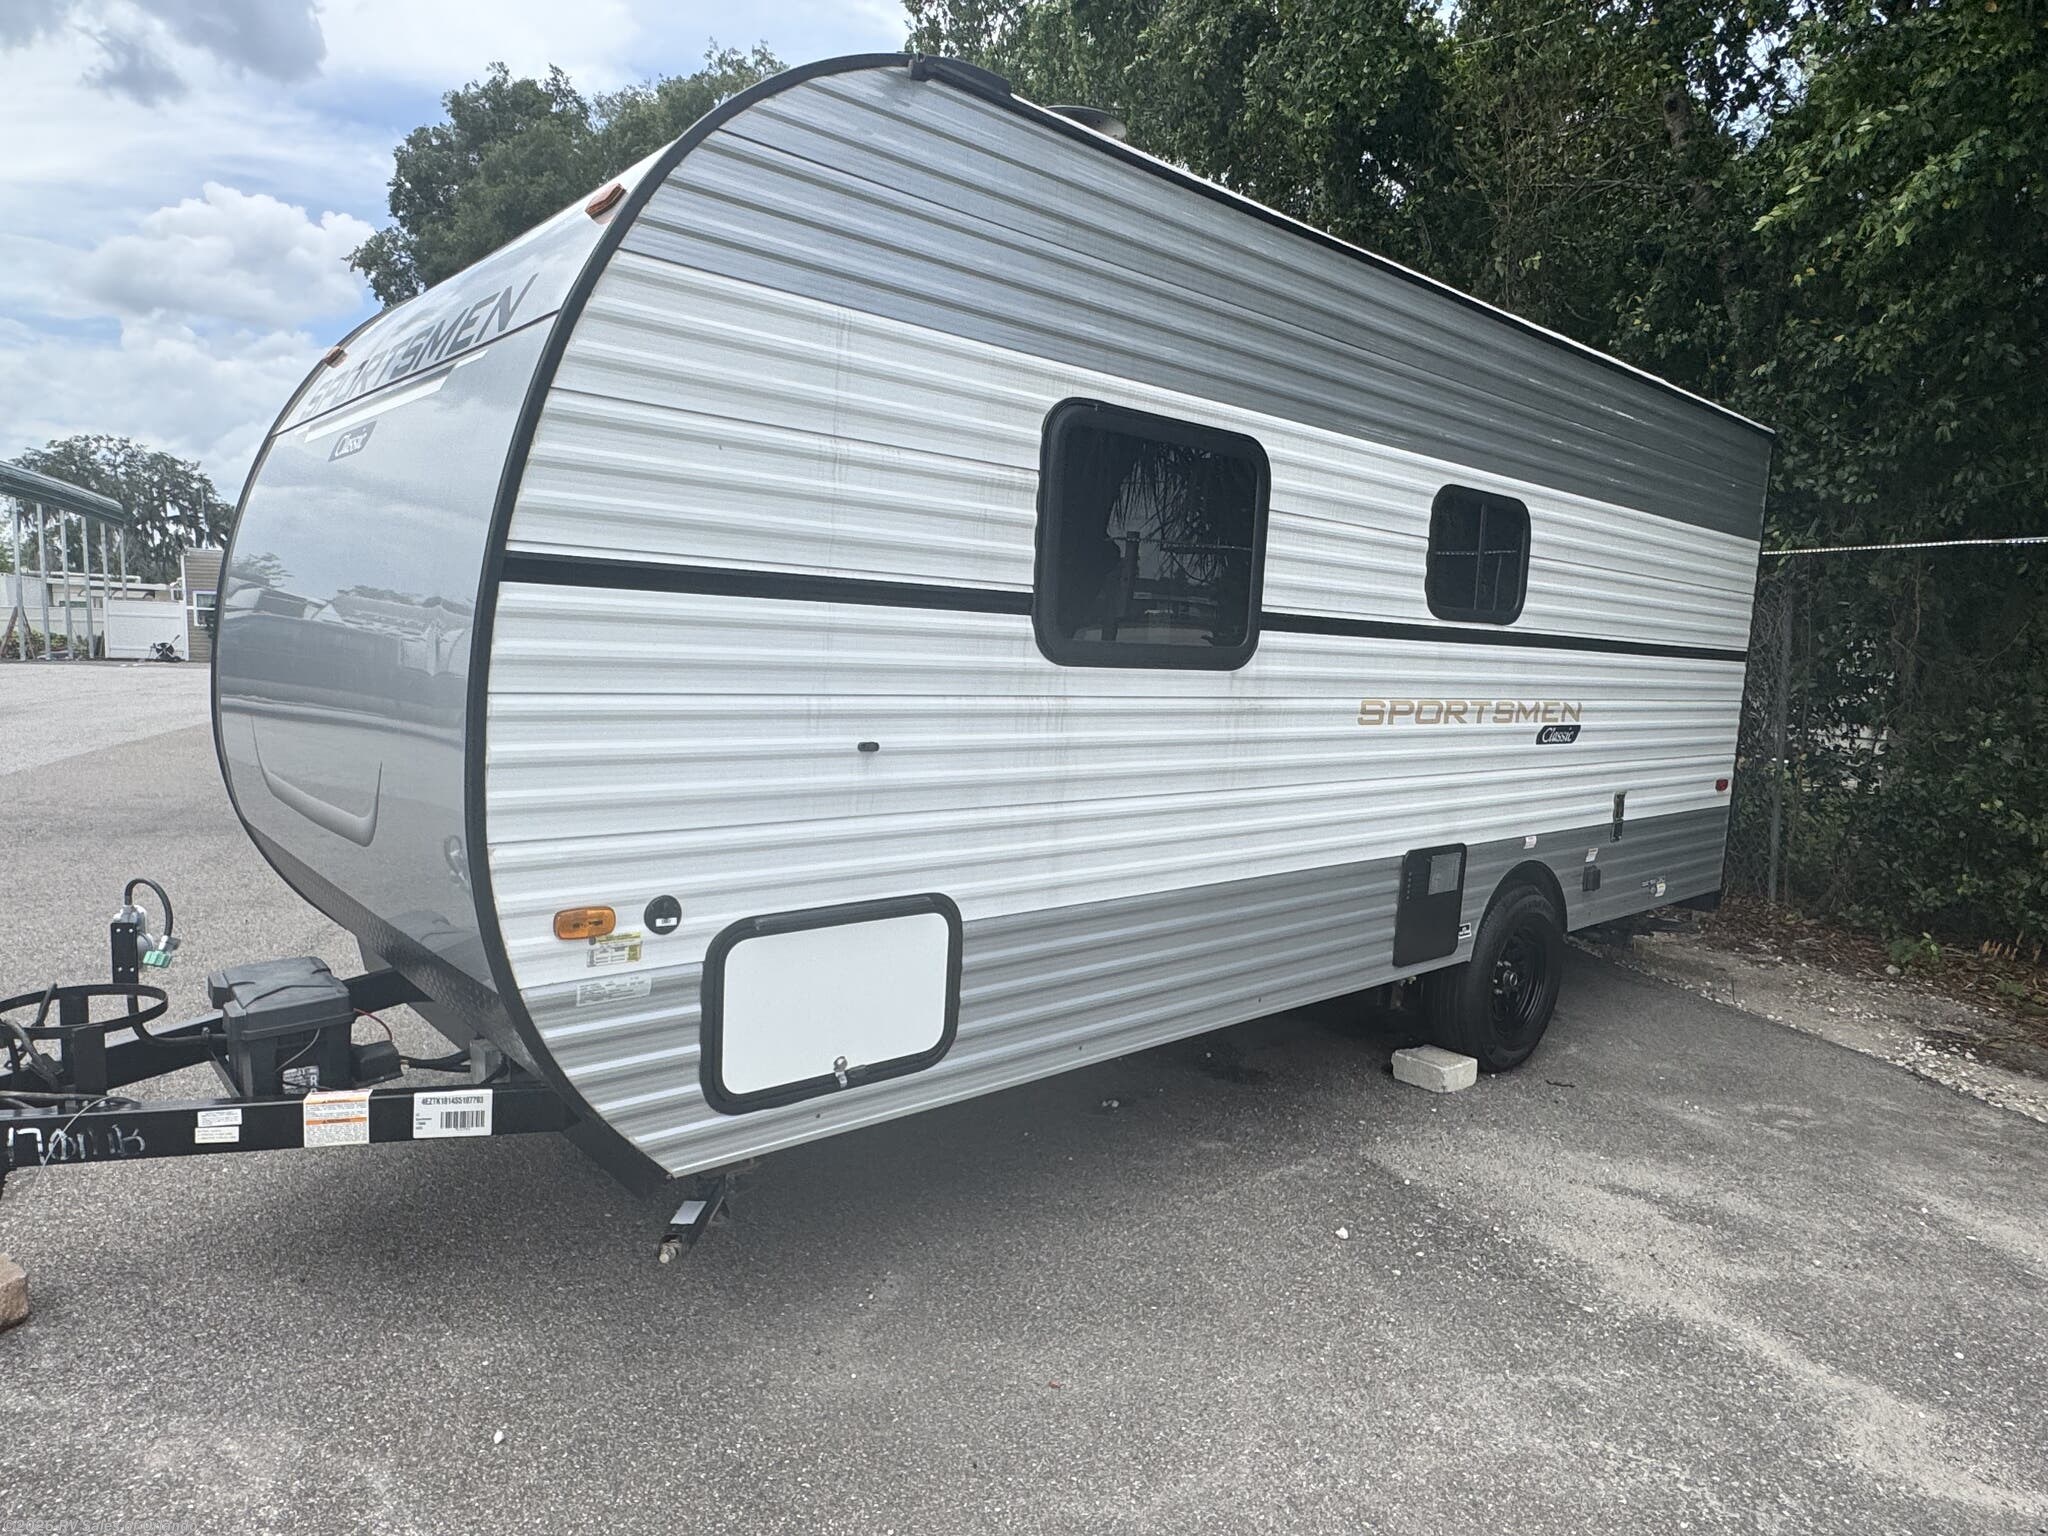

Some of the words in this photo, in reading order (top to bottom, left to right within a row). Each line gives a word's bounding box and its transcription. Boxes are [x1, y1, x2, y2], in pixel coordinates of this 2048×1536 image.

[302, 272, 539, 419] SPORTSMEN
[1358, 699, 1583, 726] SPORTSMEN
[1541, 727, 1576, 744] Classic
